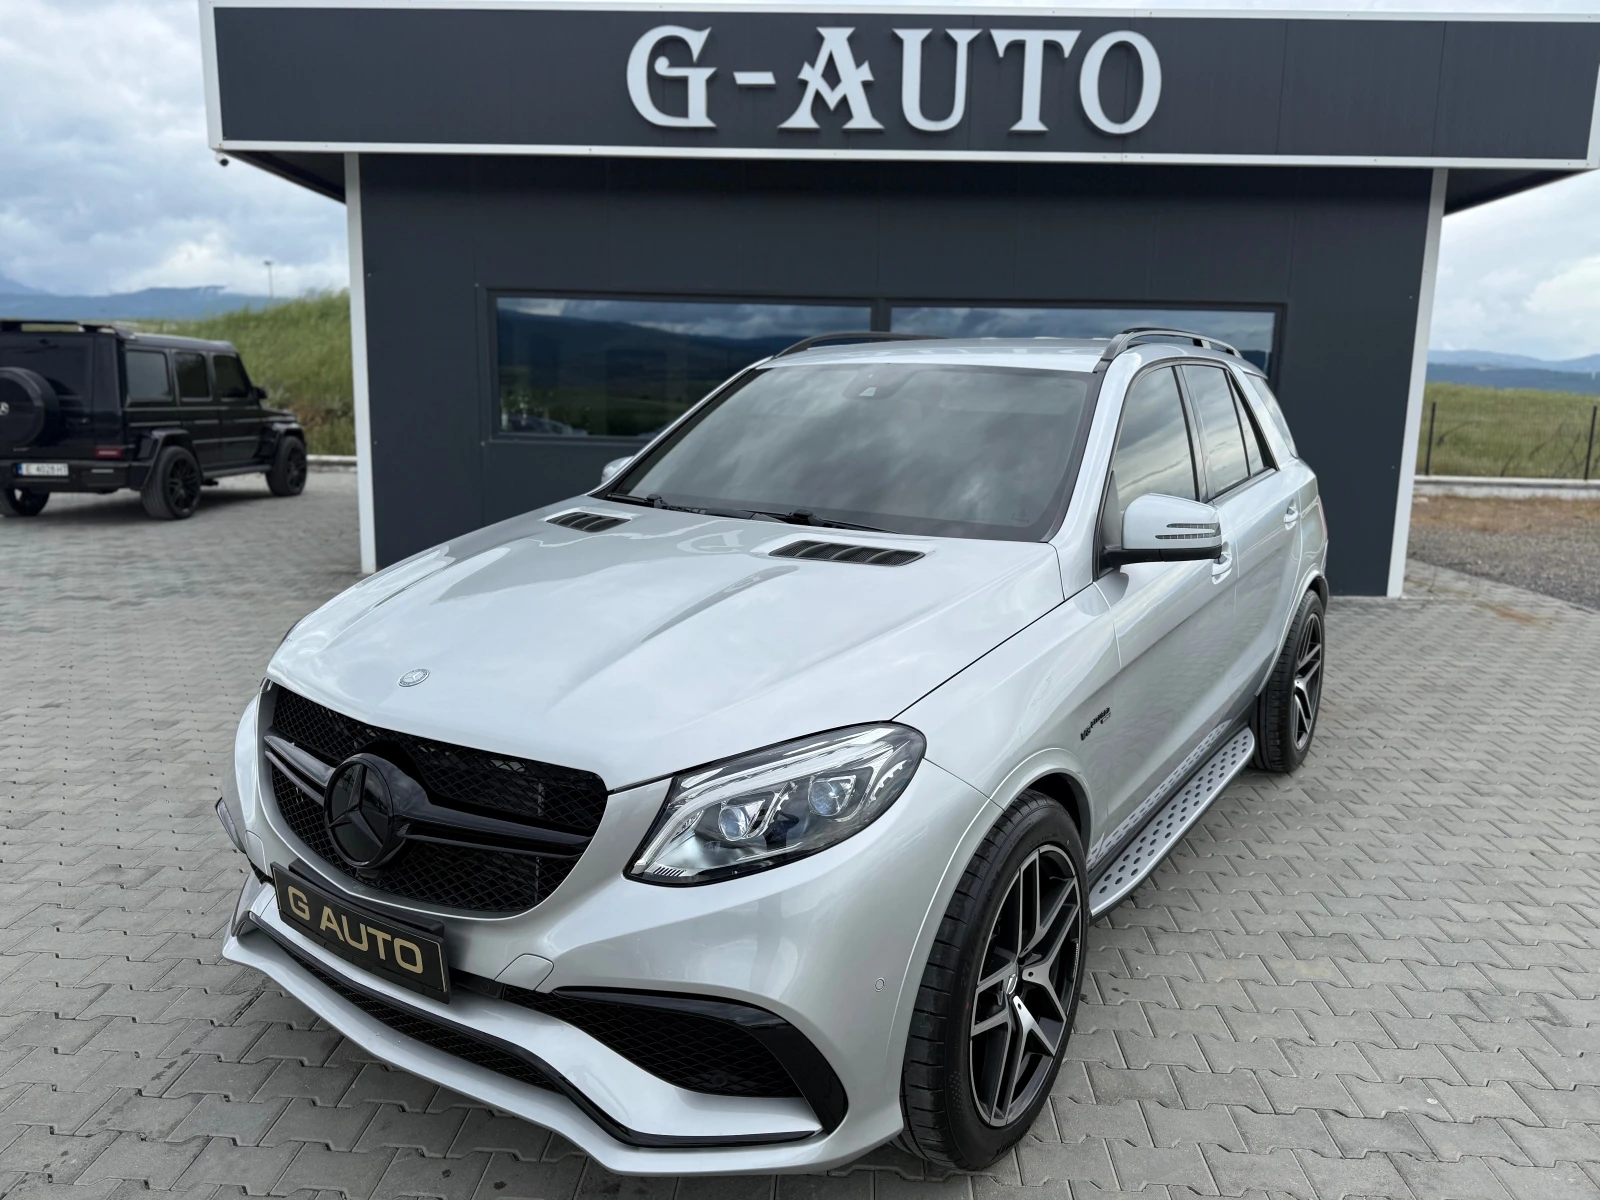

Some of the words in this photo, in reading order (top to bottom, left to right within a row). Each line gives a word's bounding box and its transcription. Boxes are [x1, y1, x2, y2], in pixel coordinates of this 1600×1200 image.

[626, 24, 1162, 135] G-AUTO
[287, 885, 311, 921] G
[319, 905, 424, 975] AUTO
